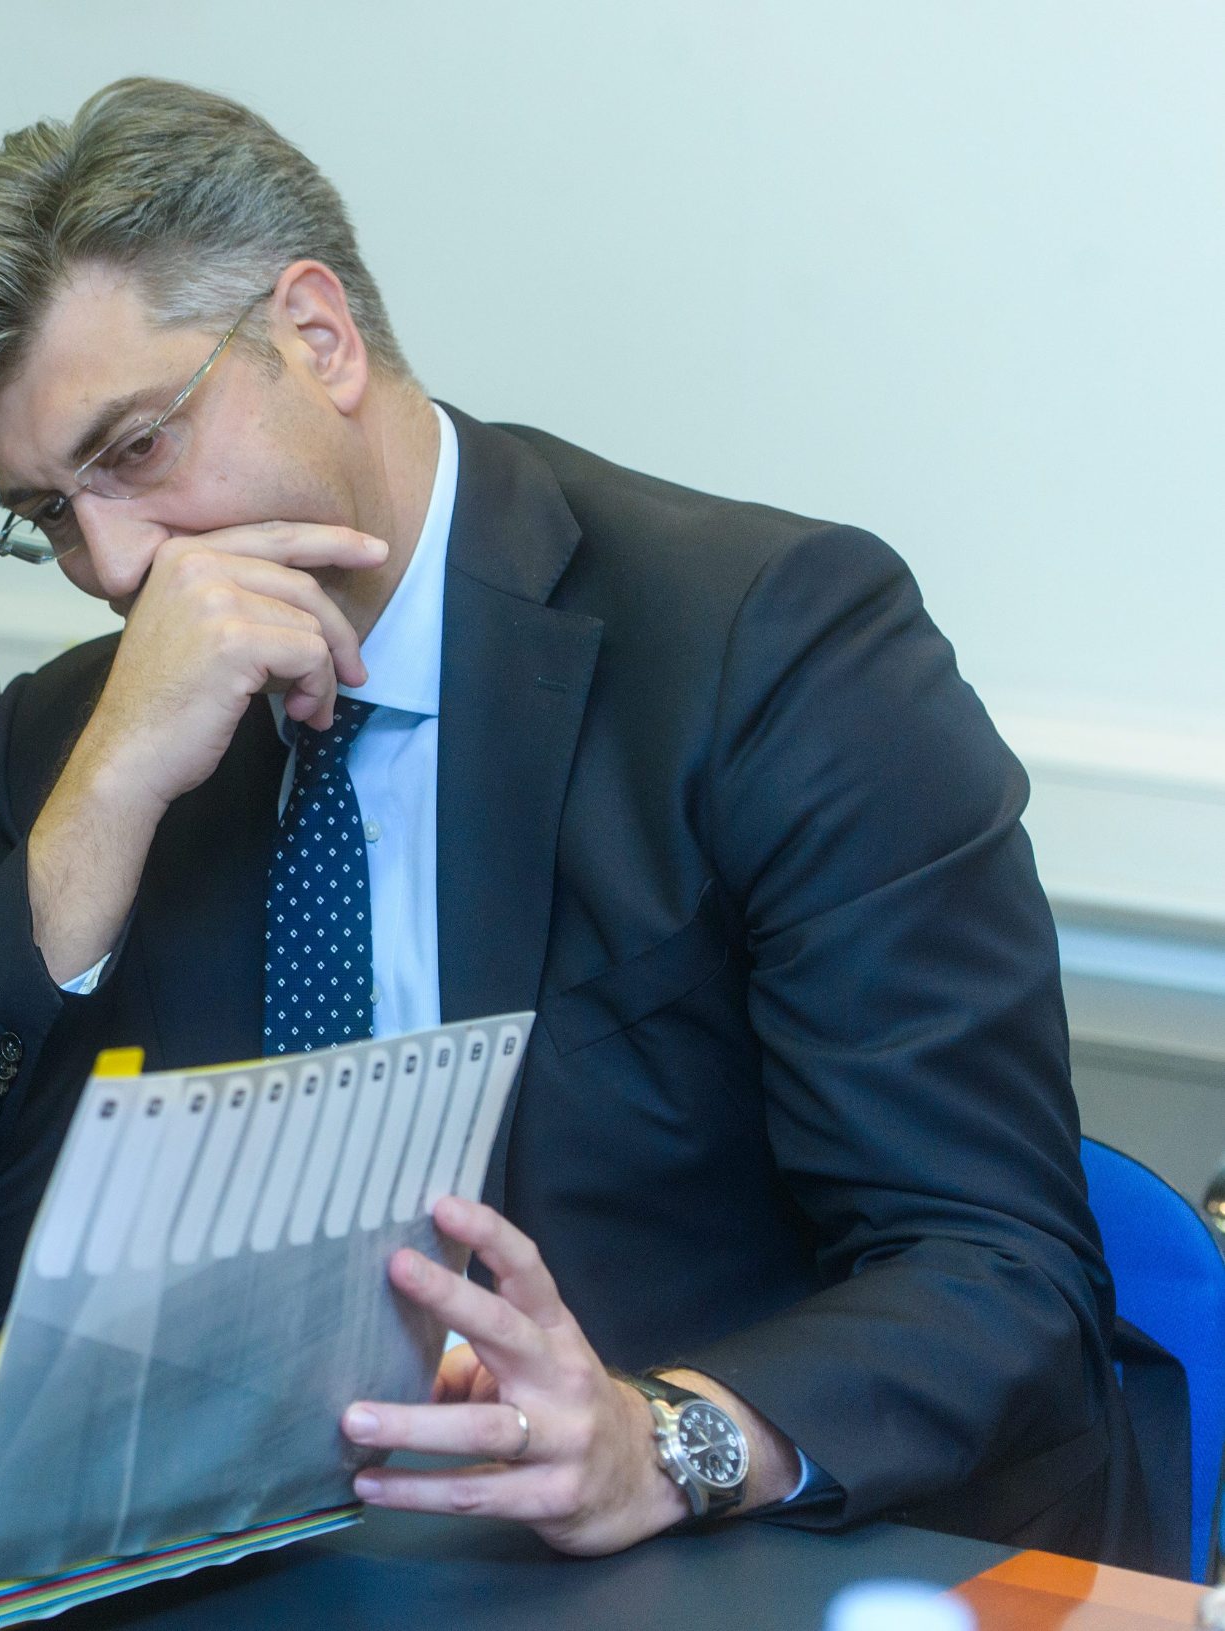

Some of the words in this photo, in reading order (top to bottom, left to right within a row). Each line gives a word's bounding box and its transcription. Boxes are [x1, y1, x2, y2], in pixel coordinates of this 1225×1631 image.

[684, 1419, 692, 1430] 5
[706, 1413, 713, 1425] 7
[717, 1422, 725, 1432] 8
[728, 1434, 737, 1447] 9
[726, 1450, 738, 1461] 10
[694, 1460, 701, 1470] 2
[706, 1469, 712, 1479] 1
